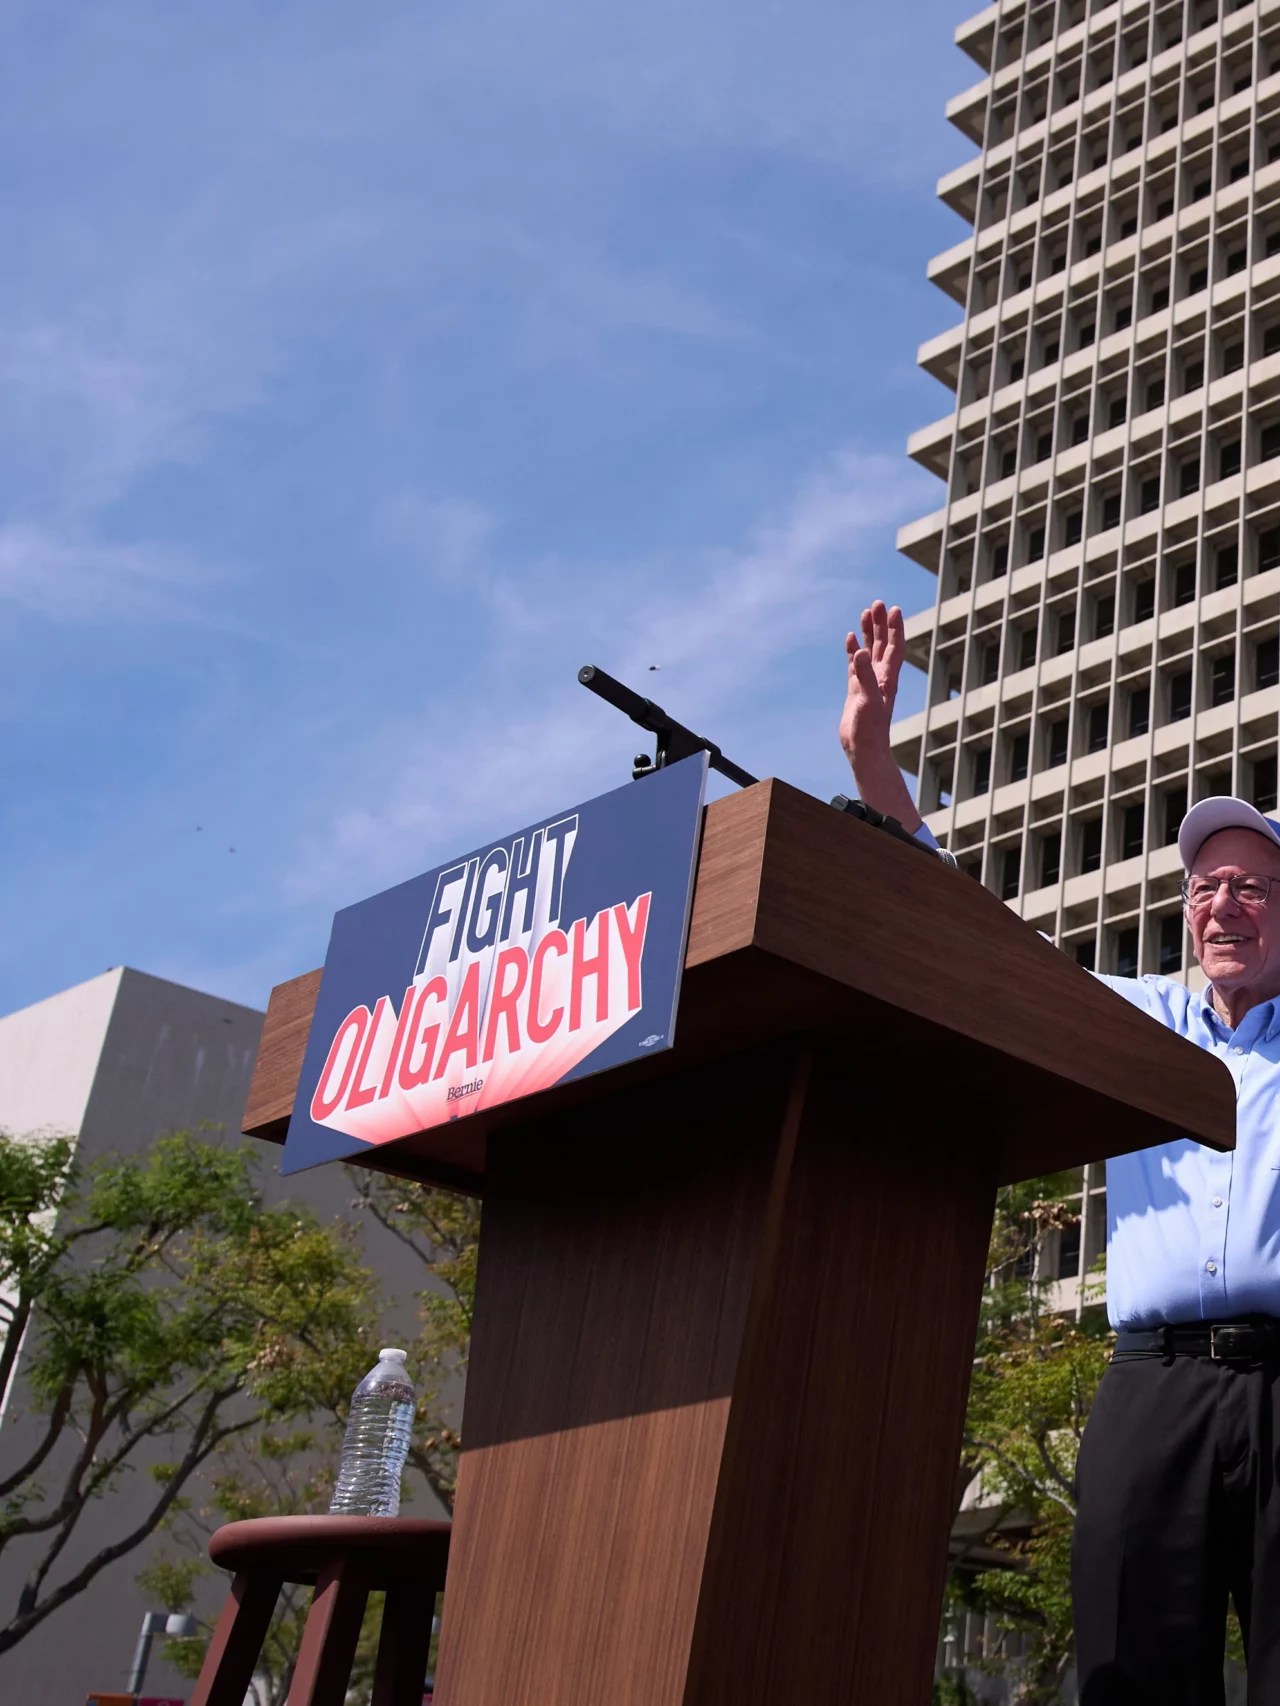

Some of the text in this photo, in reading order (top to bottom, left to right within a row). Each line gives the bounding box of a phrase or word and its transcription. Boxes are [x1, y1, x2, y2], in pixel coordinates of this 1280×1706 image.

[413, 814, 579, 977] FIGHT
[310, 891, 653, 1122] OLIGARCHY
[446, 1077, 484, 1101] Bernie
